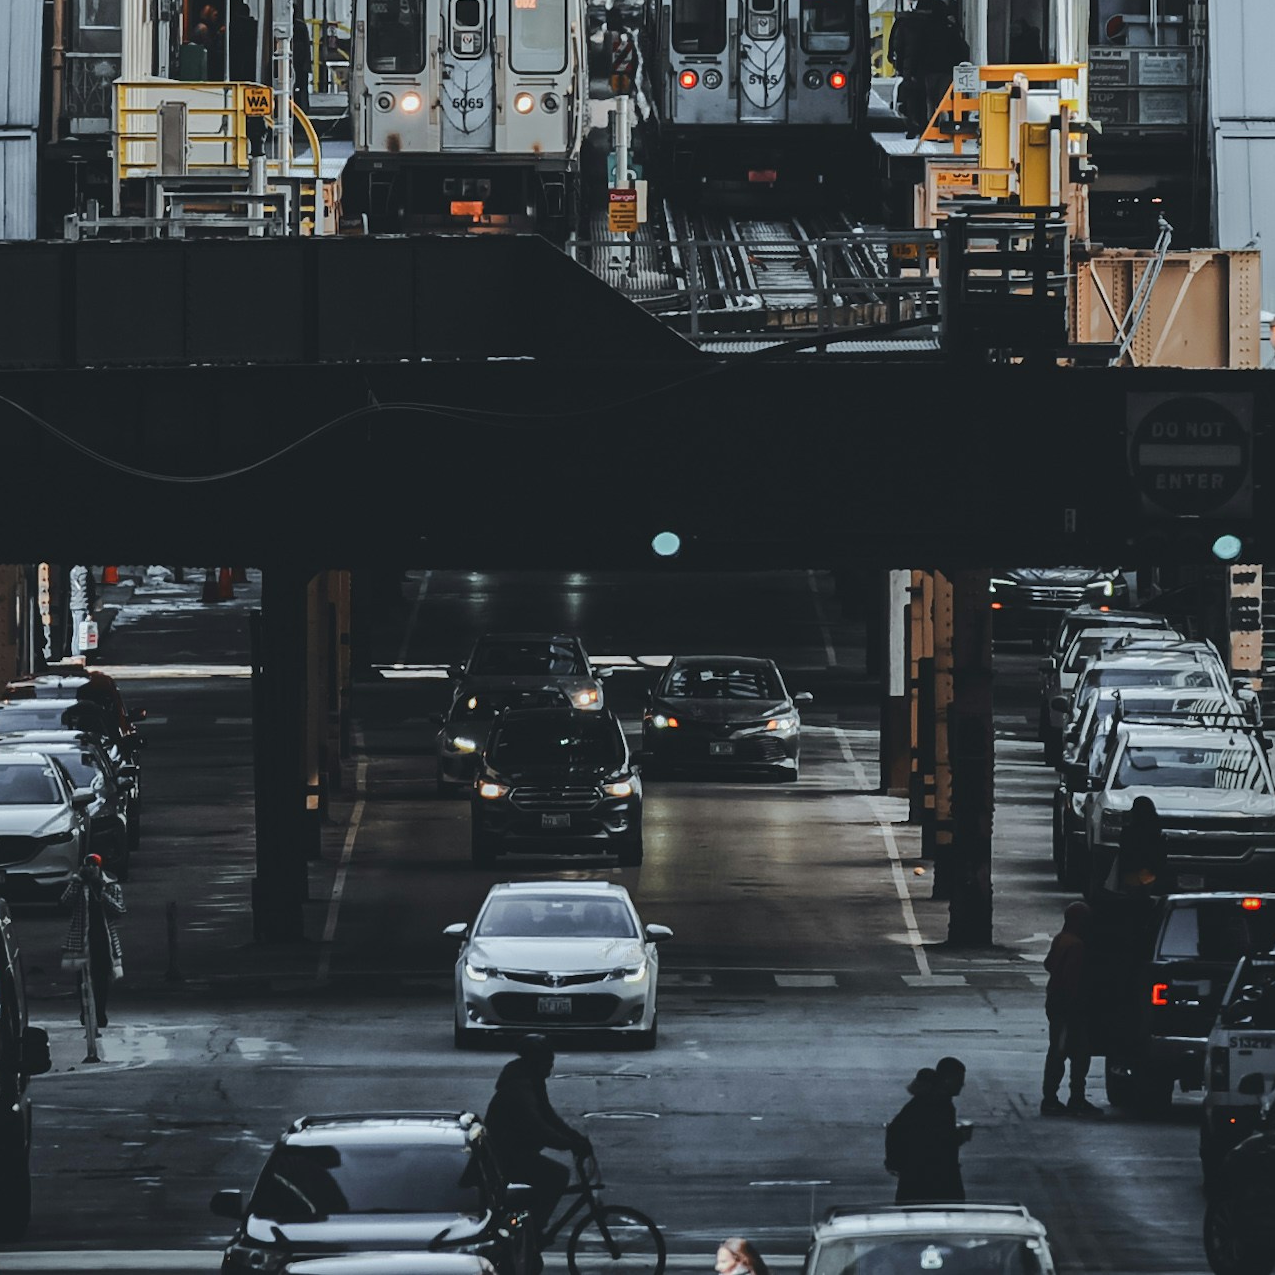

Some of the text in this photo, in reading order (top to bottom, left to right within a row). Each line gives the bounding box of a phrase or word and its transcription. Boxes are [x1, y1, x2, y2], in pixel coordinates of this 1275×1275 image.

[247, 96, 269, 108] WA
[1152, 422, 1225, 438] DO NOT
[1156, 473, 1224, 489] ENTER
